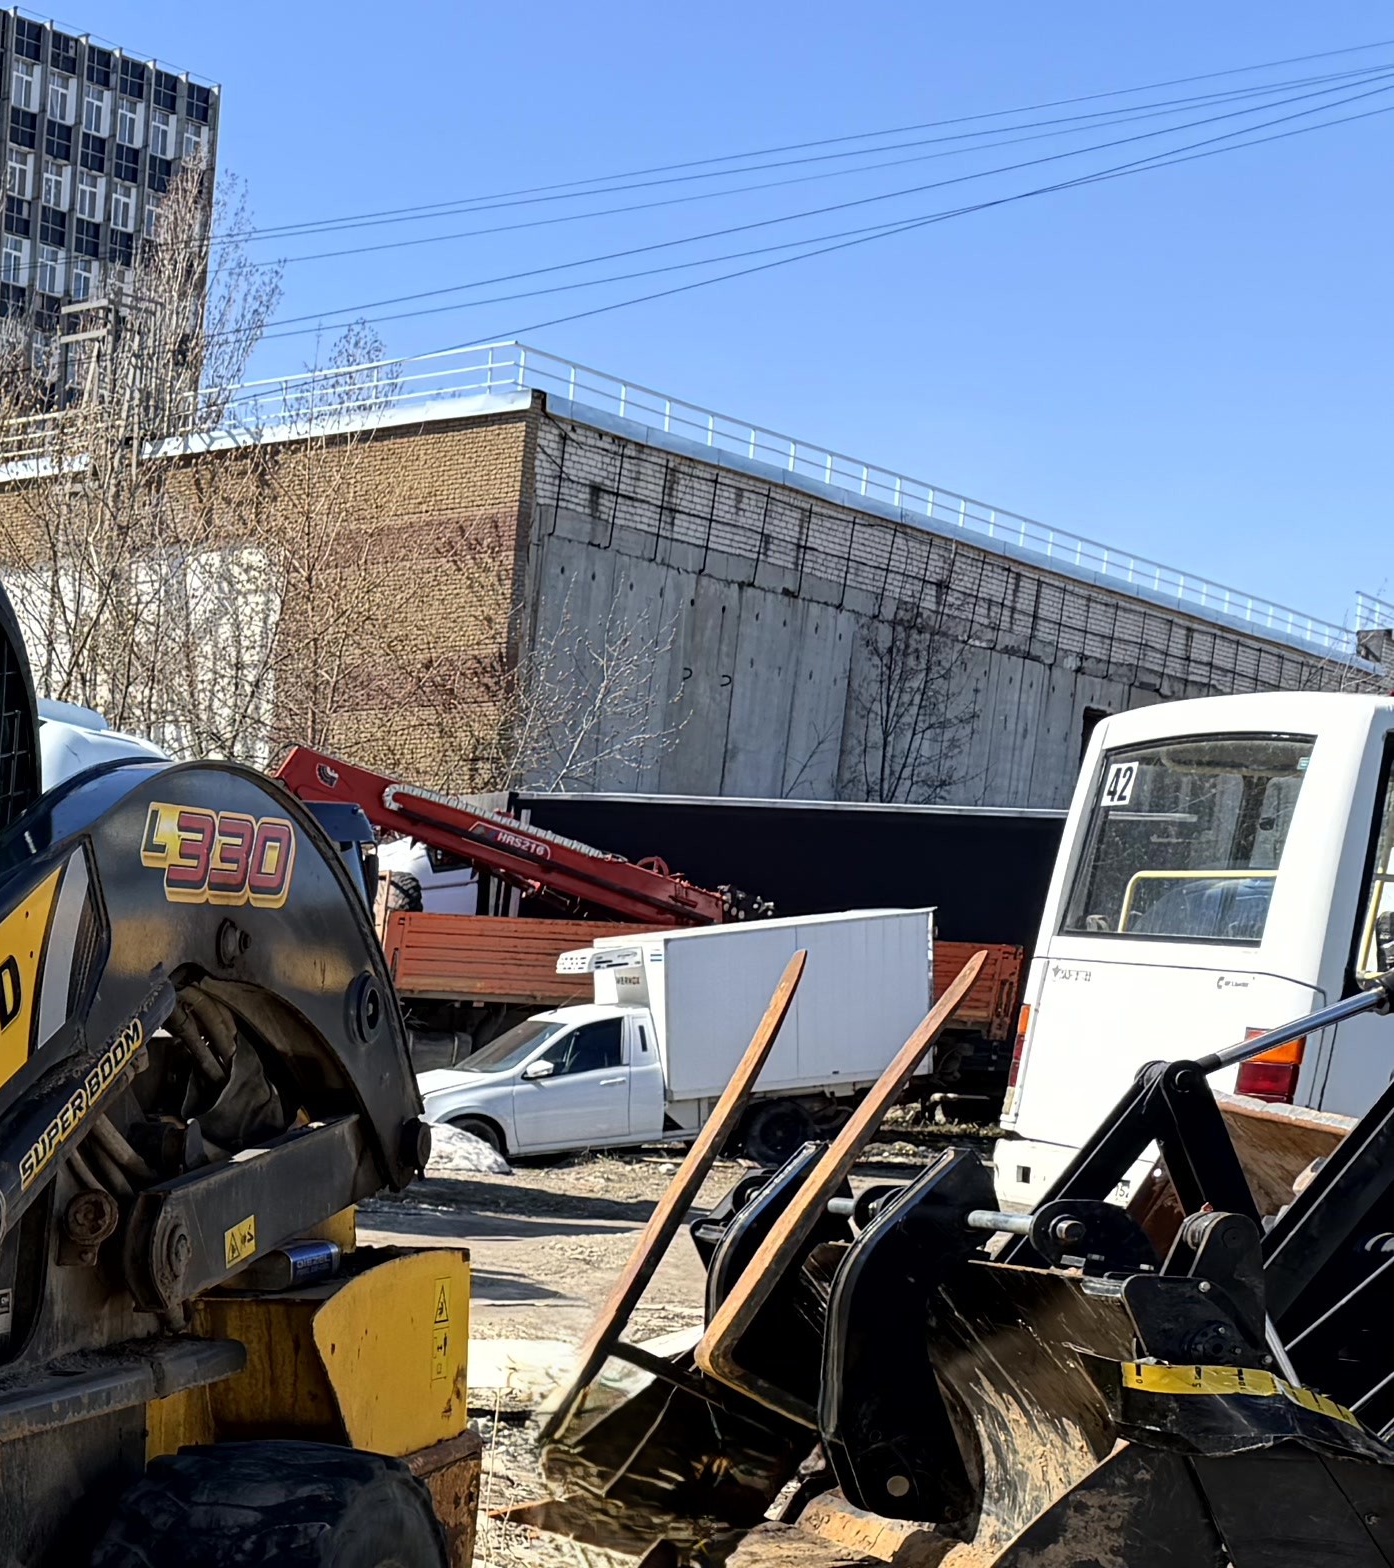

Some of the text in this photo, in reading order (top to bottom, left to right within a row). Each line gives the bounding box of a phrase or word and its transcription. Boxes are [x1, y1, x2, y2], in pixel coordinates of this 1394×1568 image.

[1107, 766, 1134, 802] 42
[141, 802, 296, 908] L330
[496, 832, 546, 856] HRS216
[19, 1018, 143, 1191] SUPER BOOM
